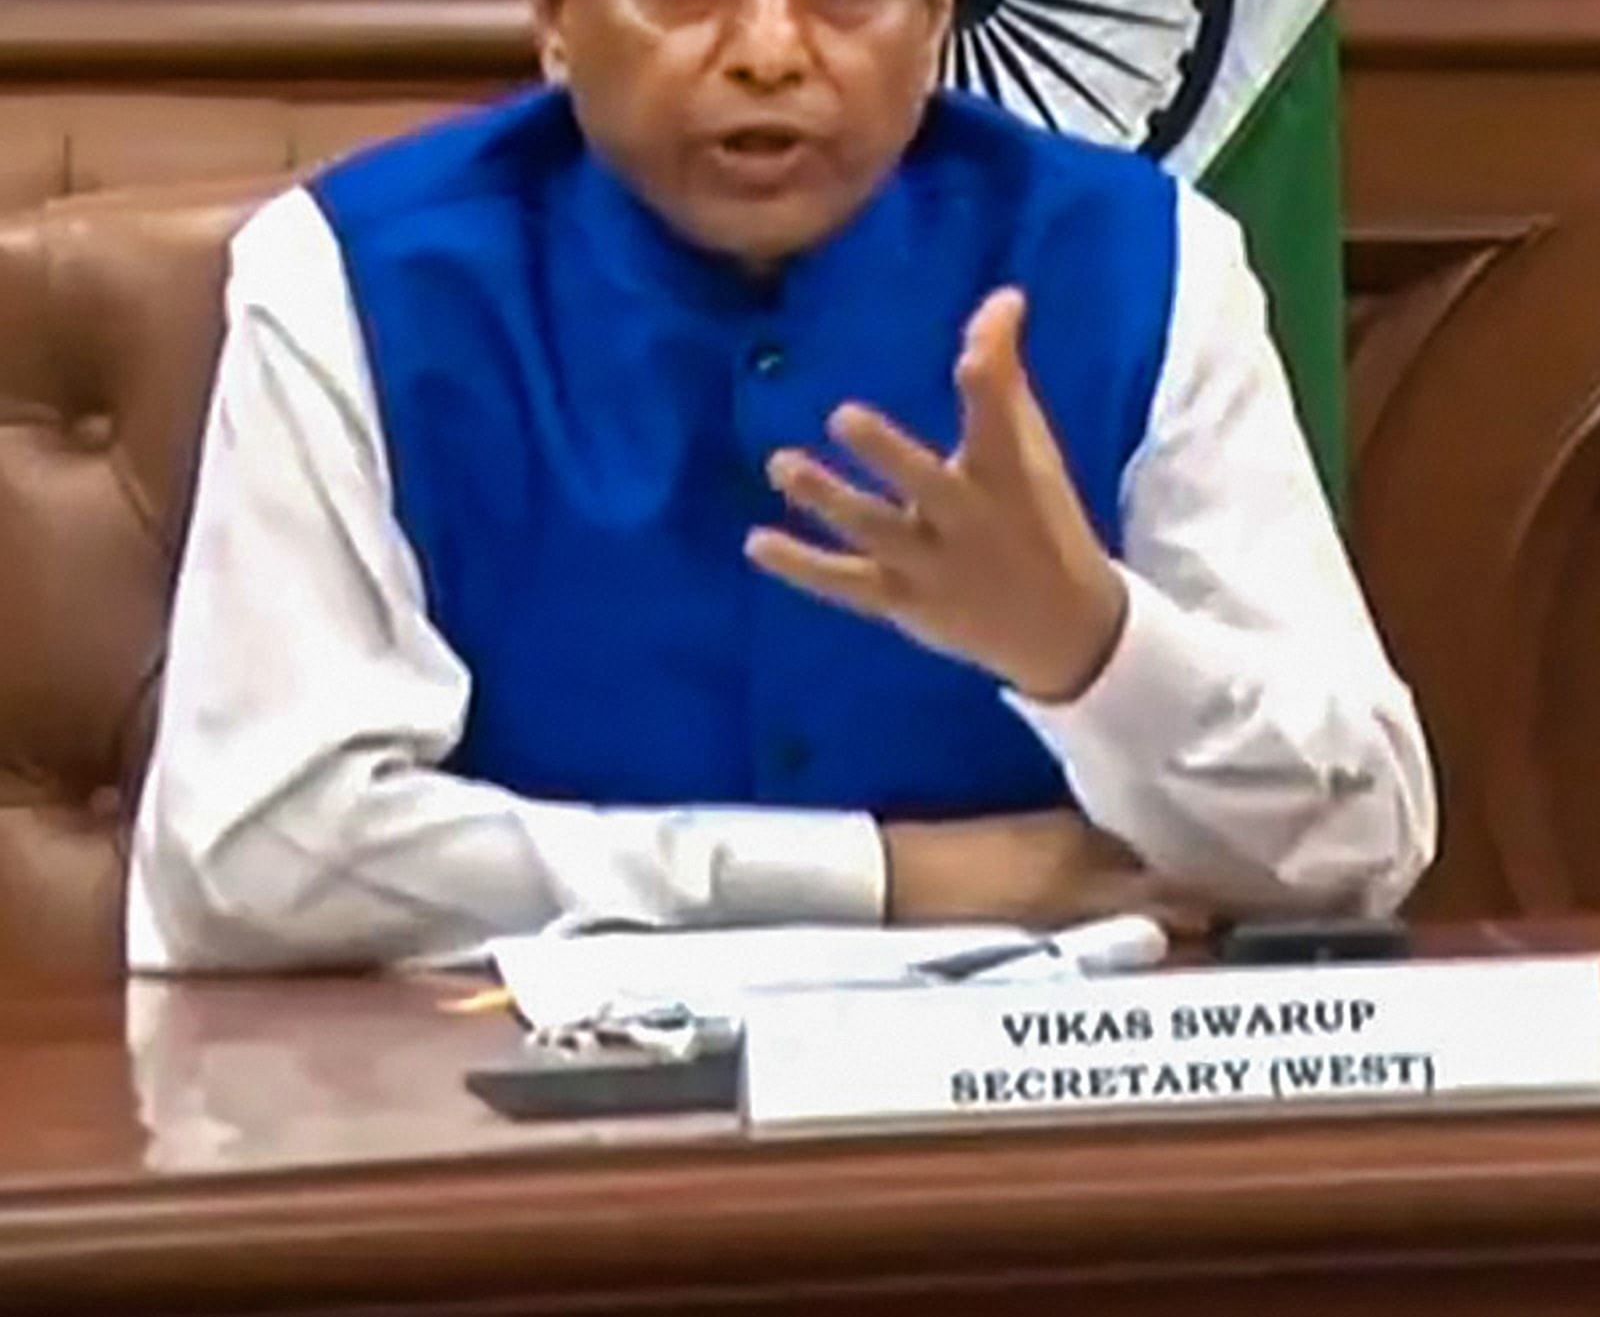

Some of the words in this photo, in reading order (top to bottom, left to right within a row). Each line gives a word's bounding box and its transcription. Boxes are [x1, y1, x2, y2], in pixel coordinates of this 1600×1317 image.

[1001, 1008, 1154, 1047] VIKAS
[1170, 999, 1376, 1040] SWARUP
[950, 1058, 1251, 1104] SECRETARY
[1269, 1052, 1436, 1100] (WEST)
